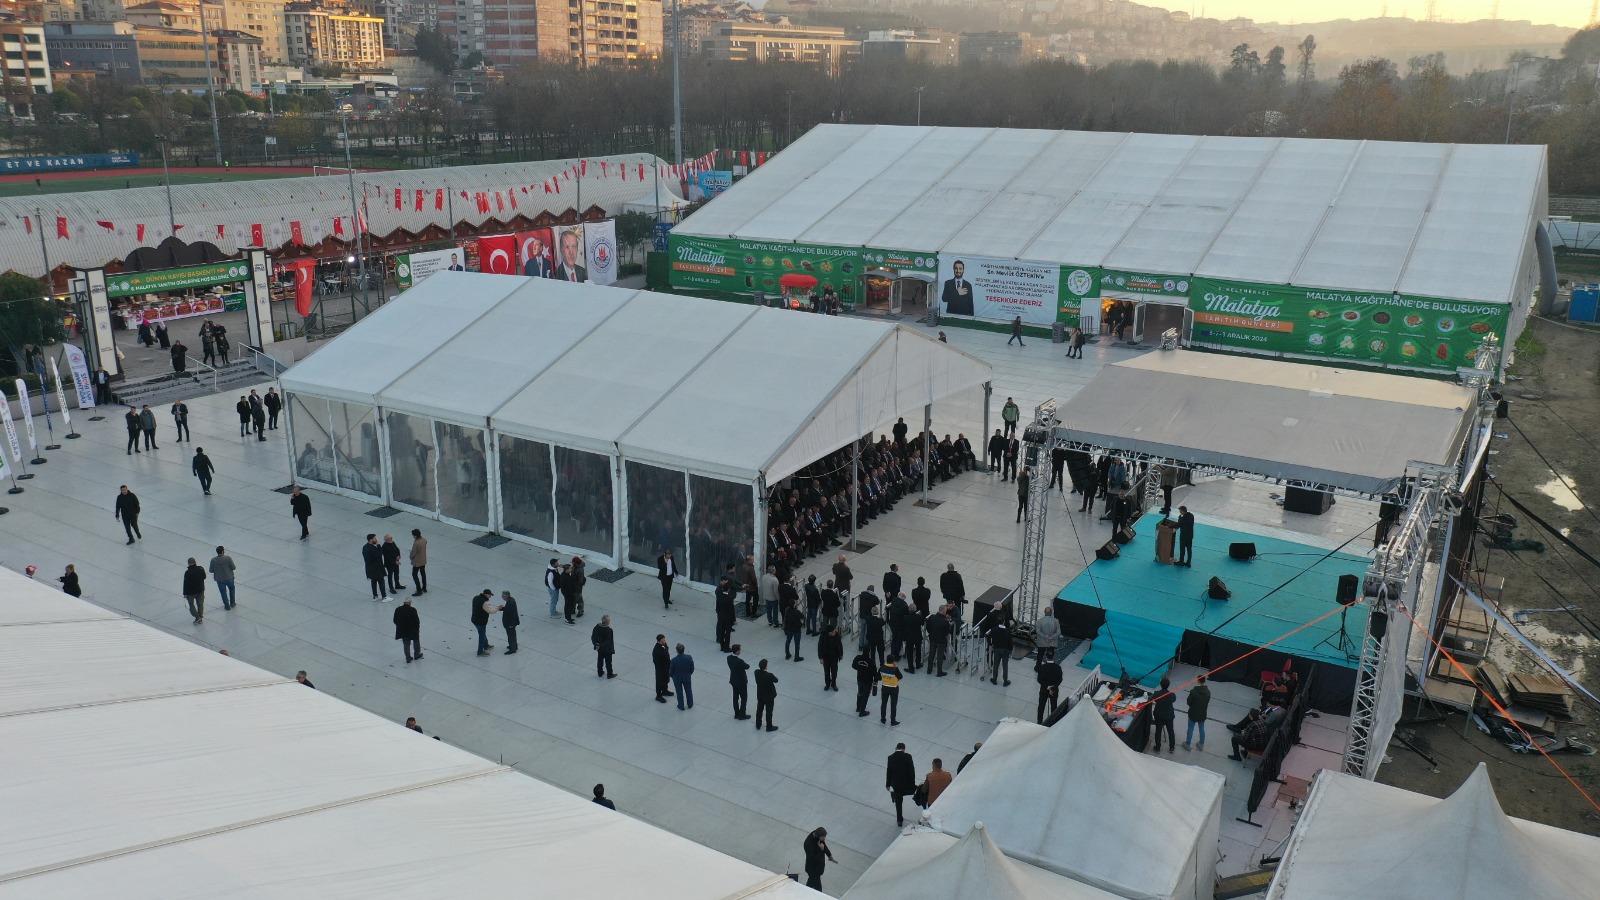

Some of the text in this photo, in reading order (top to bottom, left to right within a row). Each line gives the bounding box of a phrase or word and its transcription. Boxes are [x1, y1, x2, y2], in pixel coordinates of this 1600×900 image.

[47, 158, 84, 166] KAZAN
[739, 243, 768, 251] MALATYA
[676, 246, 726, 267] Malatya
[145, 275, 167, 283] DÜNYA
[985, 295, 1018, 305] TEŞEKKÜR
[1019, 299, 1043, 307] EDERİZ
[1203, 292, 1281, 321] Malatya
[1306, 292, 1501, 316] MALATYA KAĞITHANE'DE BULUŞUYOR!
[1205, 315, 1281, 329] TANITIM GÜNLERİ
[1226, 331, 1251, 341] ARALIK
